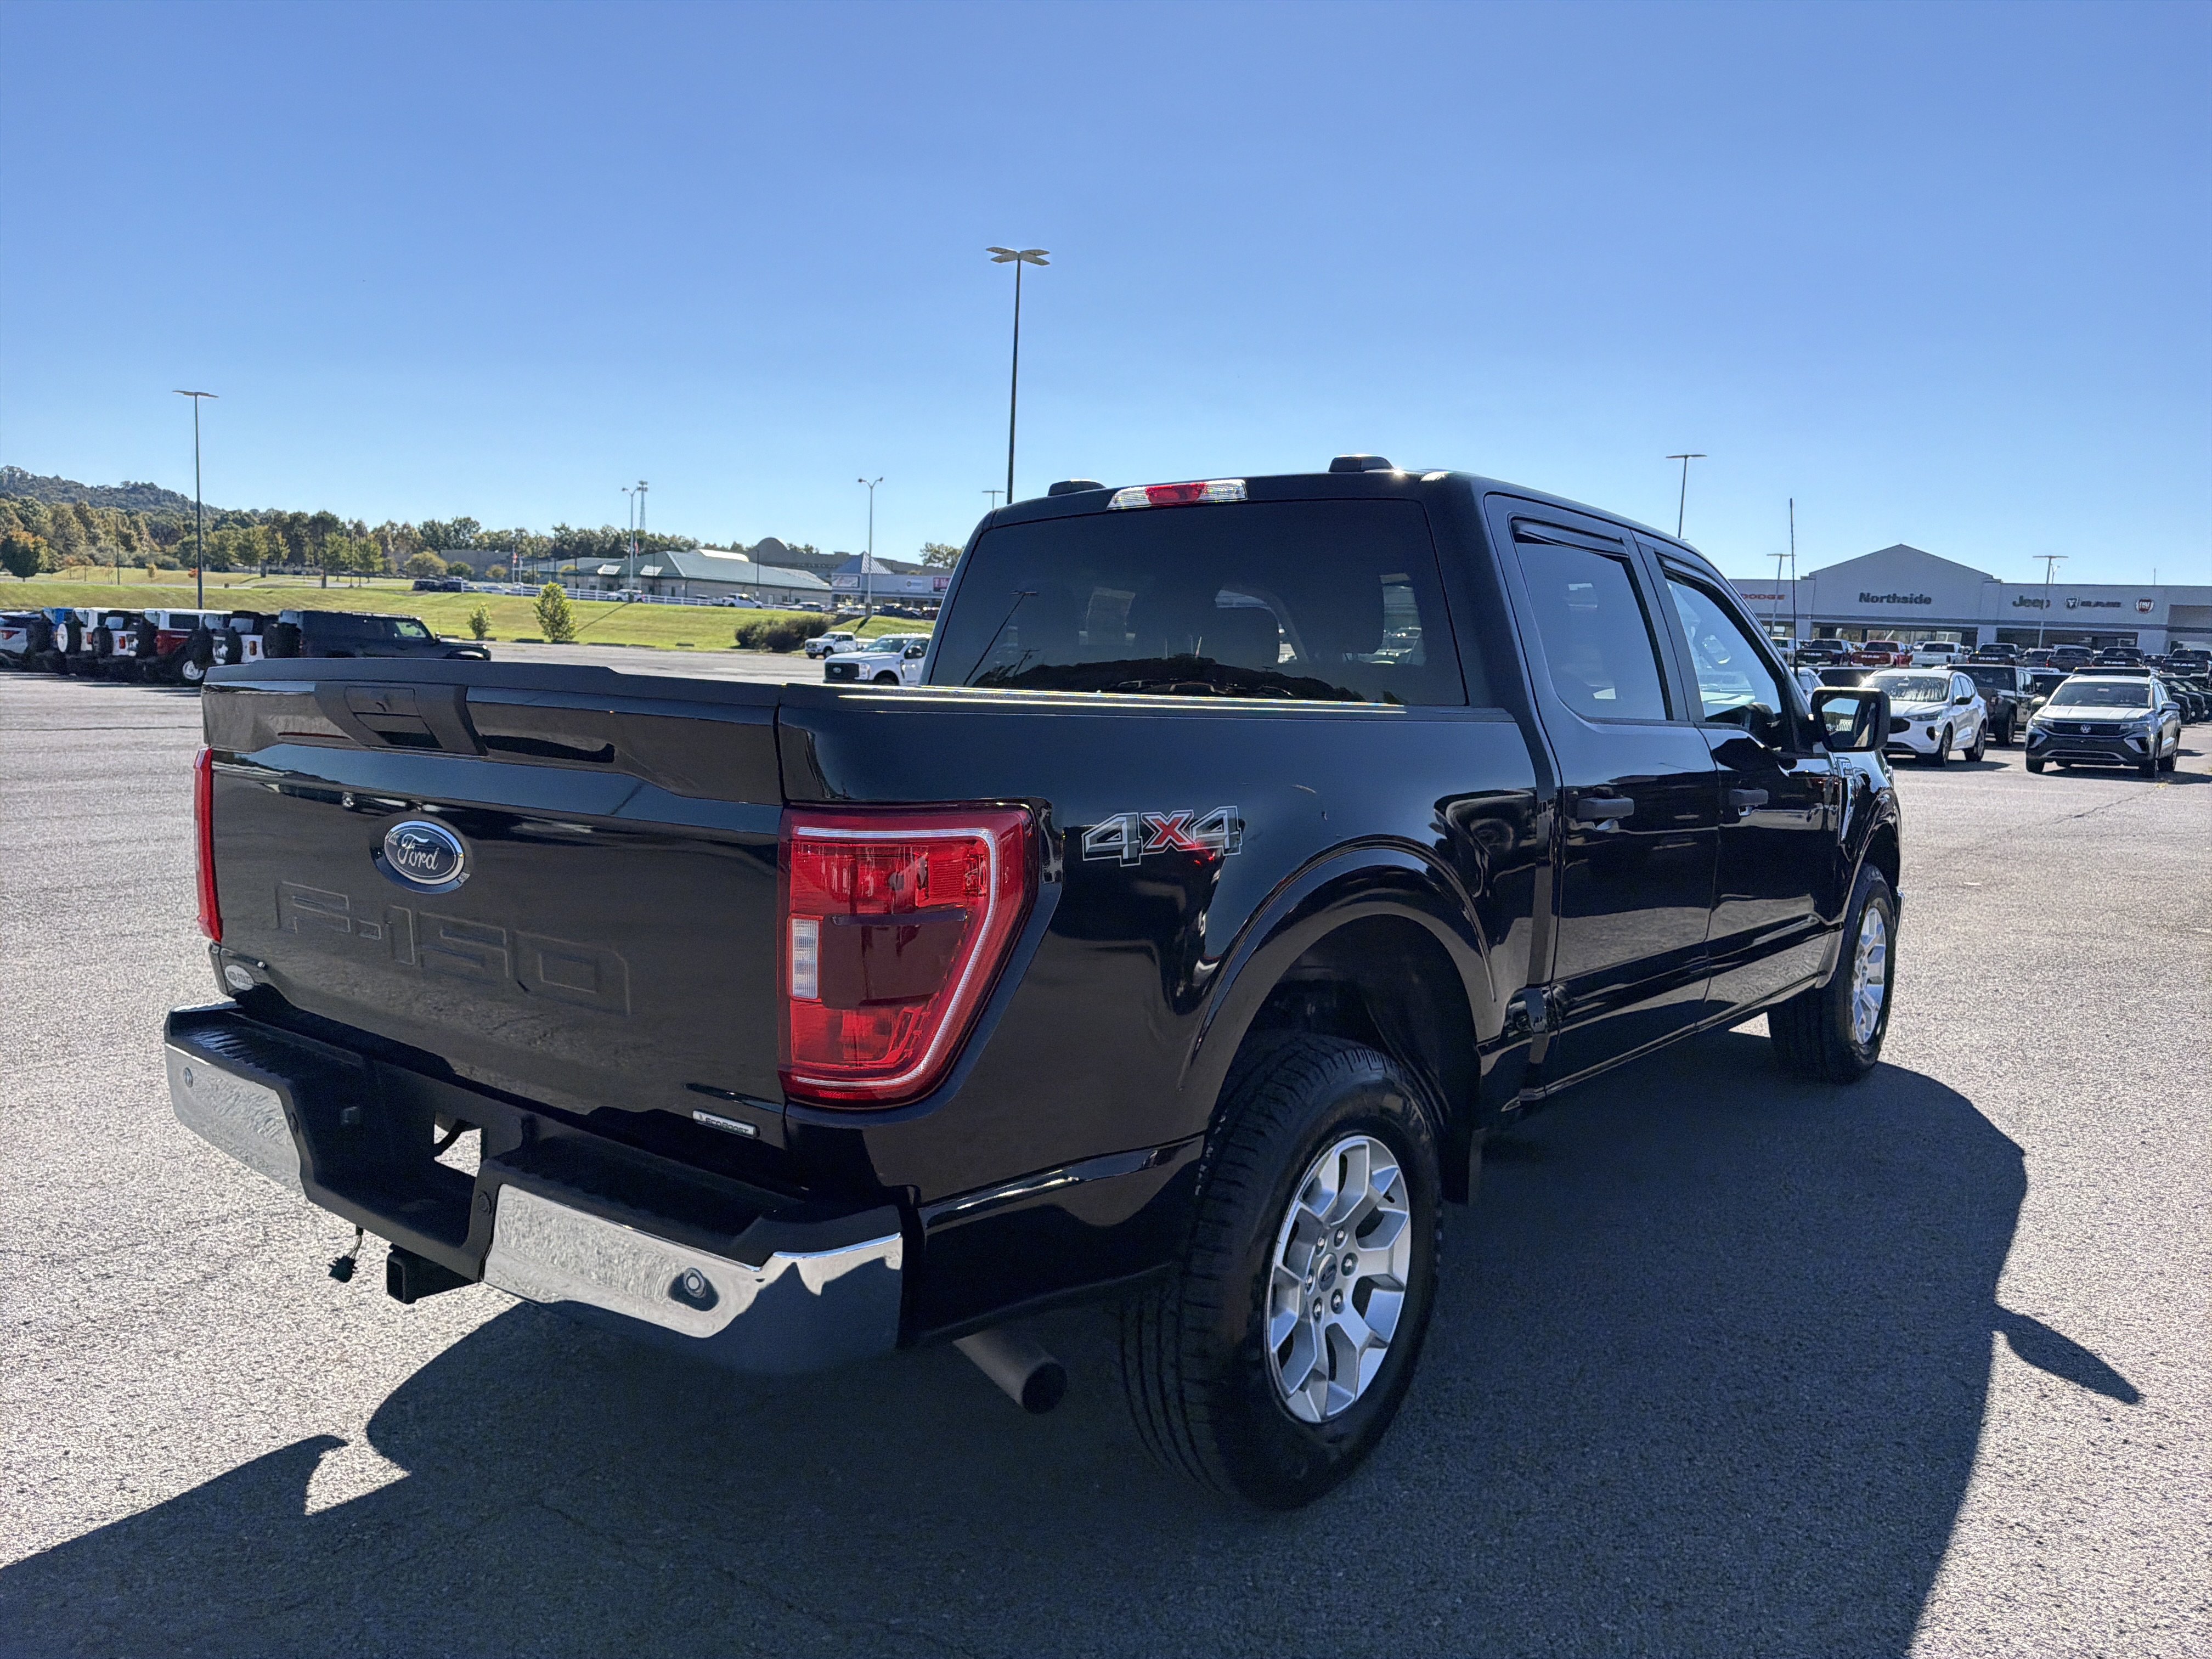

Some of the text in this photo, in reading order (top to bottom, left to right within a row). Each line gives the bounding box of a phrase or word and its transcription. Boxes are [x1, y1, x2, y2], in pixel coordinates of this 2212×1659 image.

[1858, 592, 1932, 605] Northside
[2012, 595, 2051, 610] Jeep
[398, 833, 440, 870] Ford
[275, 881, 631, 1017] F-150
